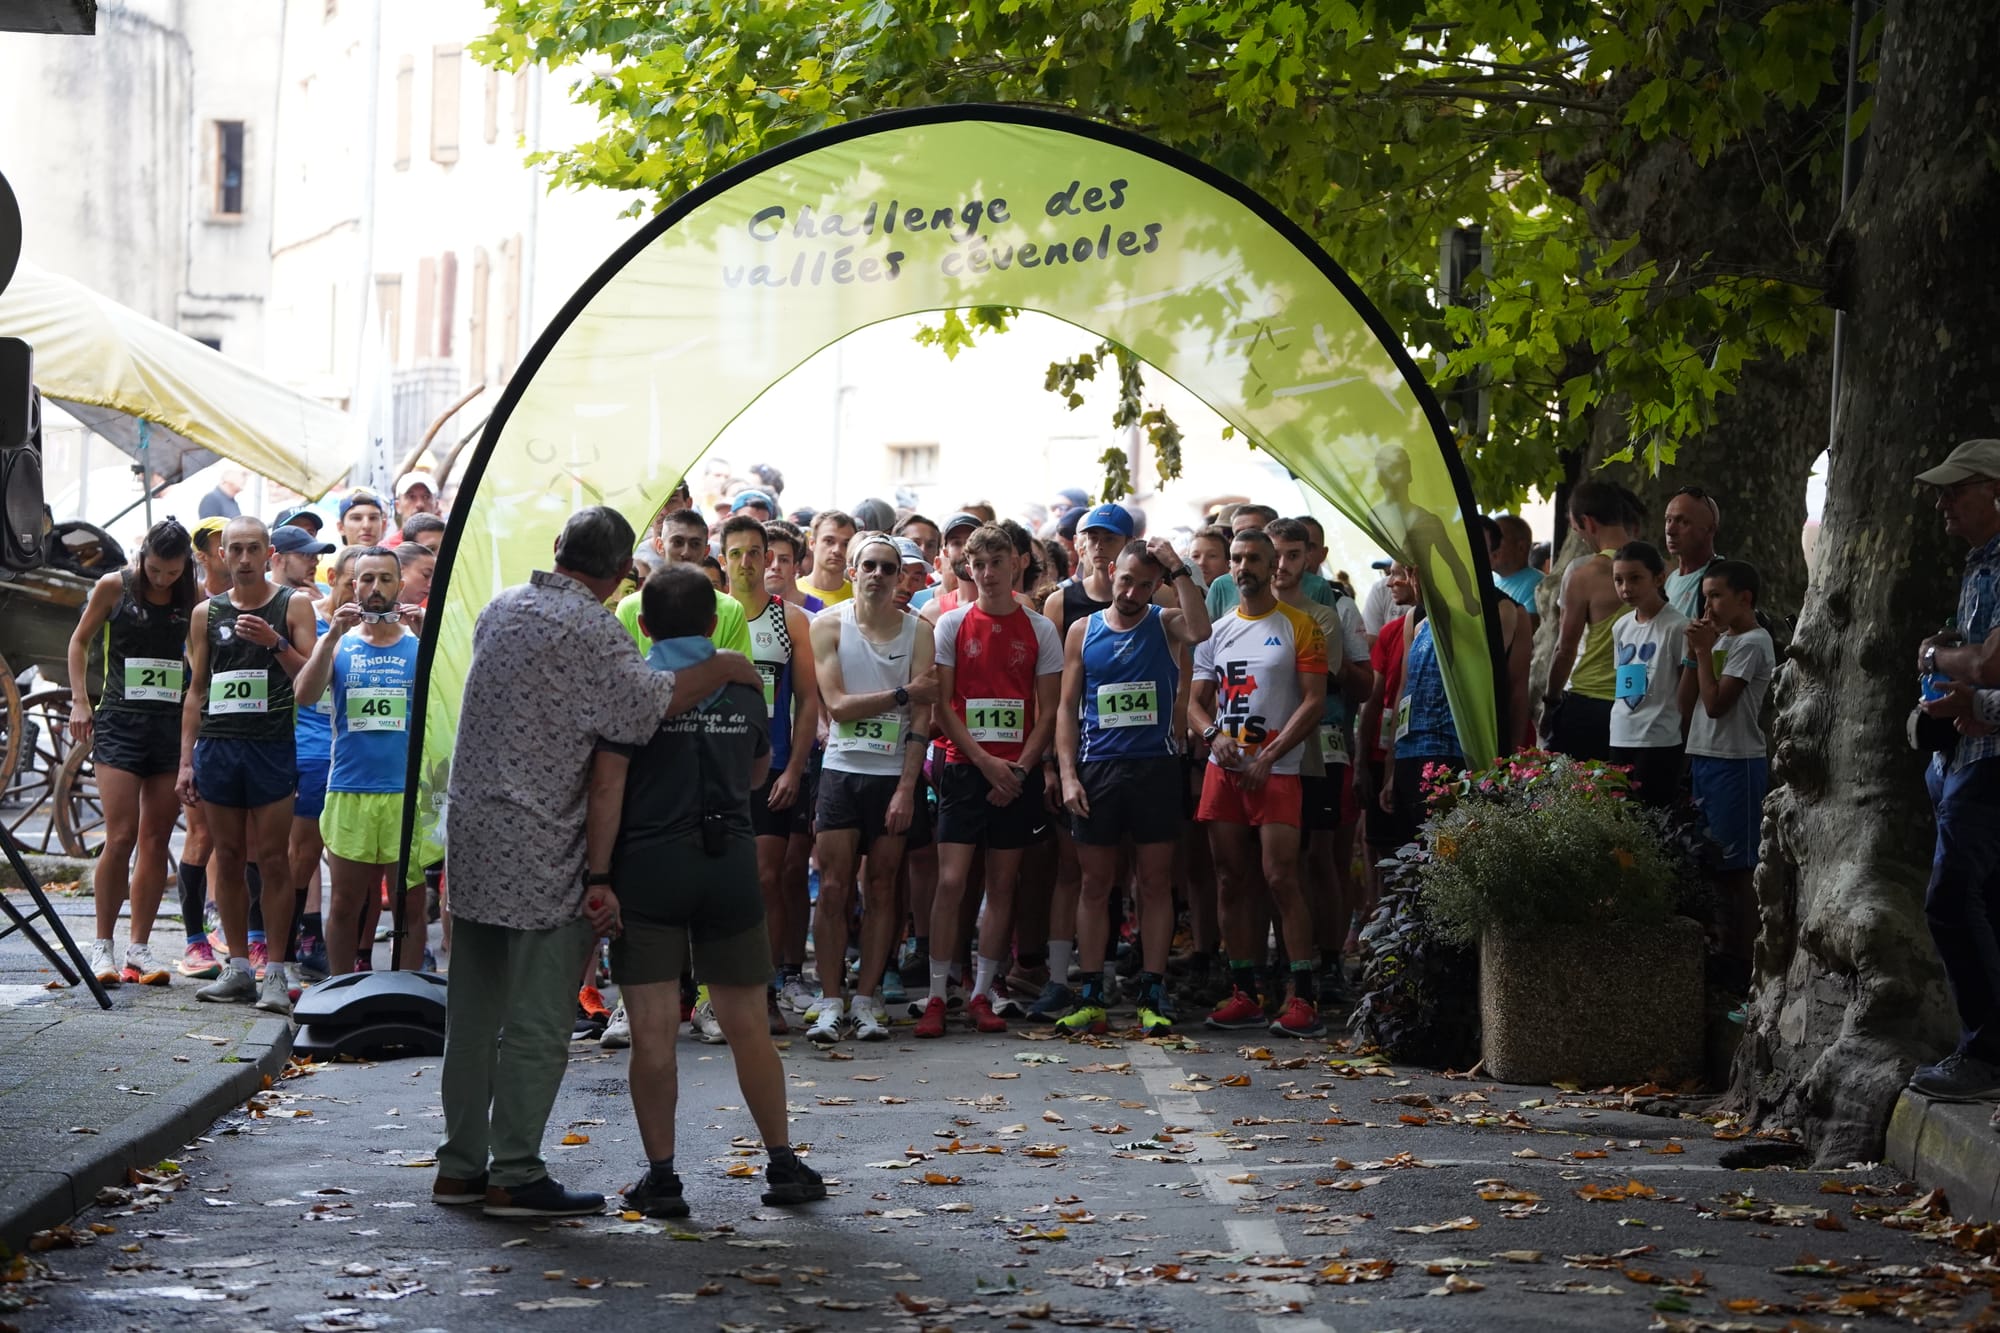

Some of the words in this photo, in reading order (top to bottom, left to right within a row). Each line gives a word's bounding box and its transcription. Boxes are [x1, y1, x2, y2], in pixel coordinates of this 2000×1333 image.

[748, 198, 1011, 243] Challenge
[1045, 179, 1129, 216] des
[722, 246, 905, 289] vallées
[941, 222, 1163, 277] cévenoles
[141, 669, 167, 687] 21
[1625, 677, 1633, 689] 5
[223, 681, 251, 699] 20
[361, 699, 392, 716] 46
[1106, 692, 1150, 713] 134
[729, 713, 747, 723] des
[975, 710, 1017, 728] 113
[854, 722, 883, 739] 53
